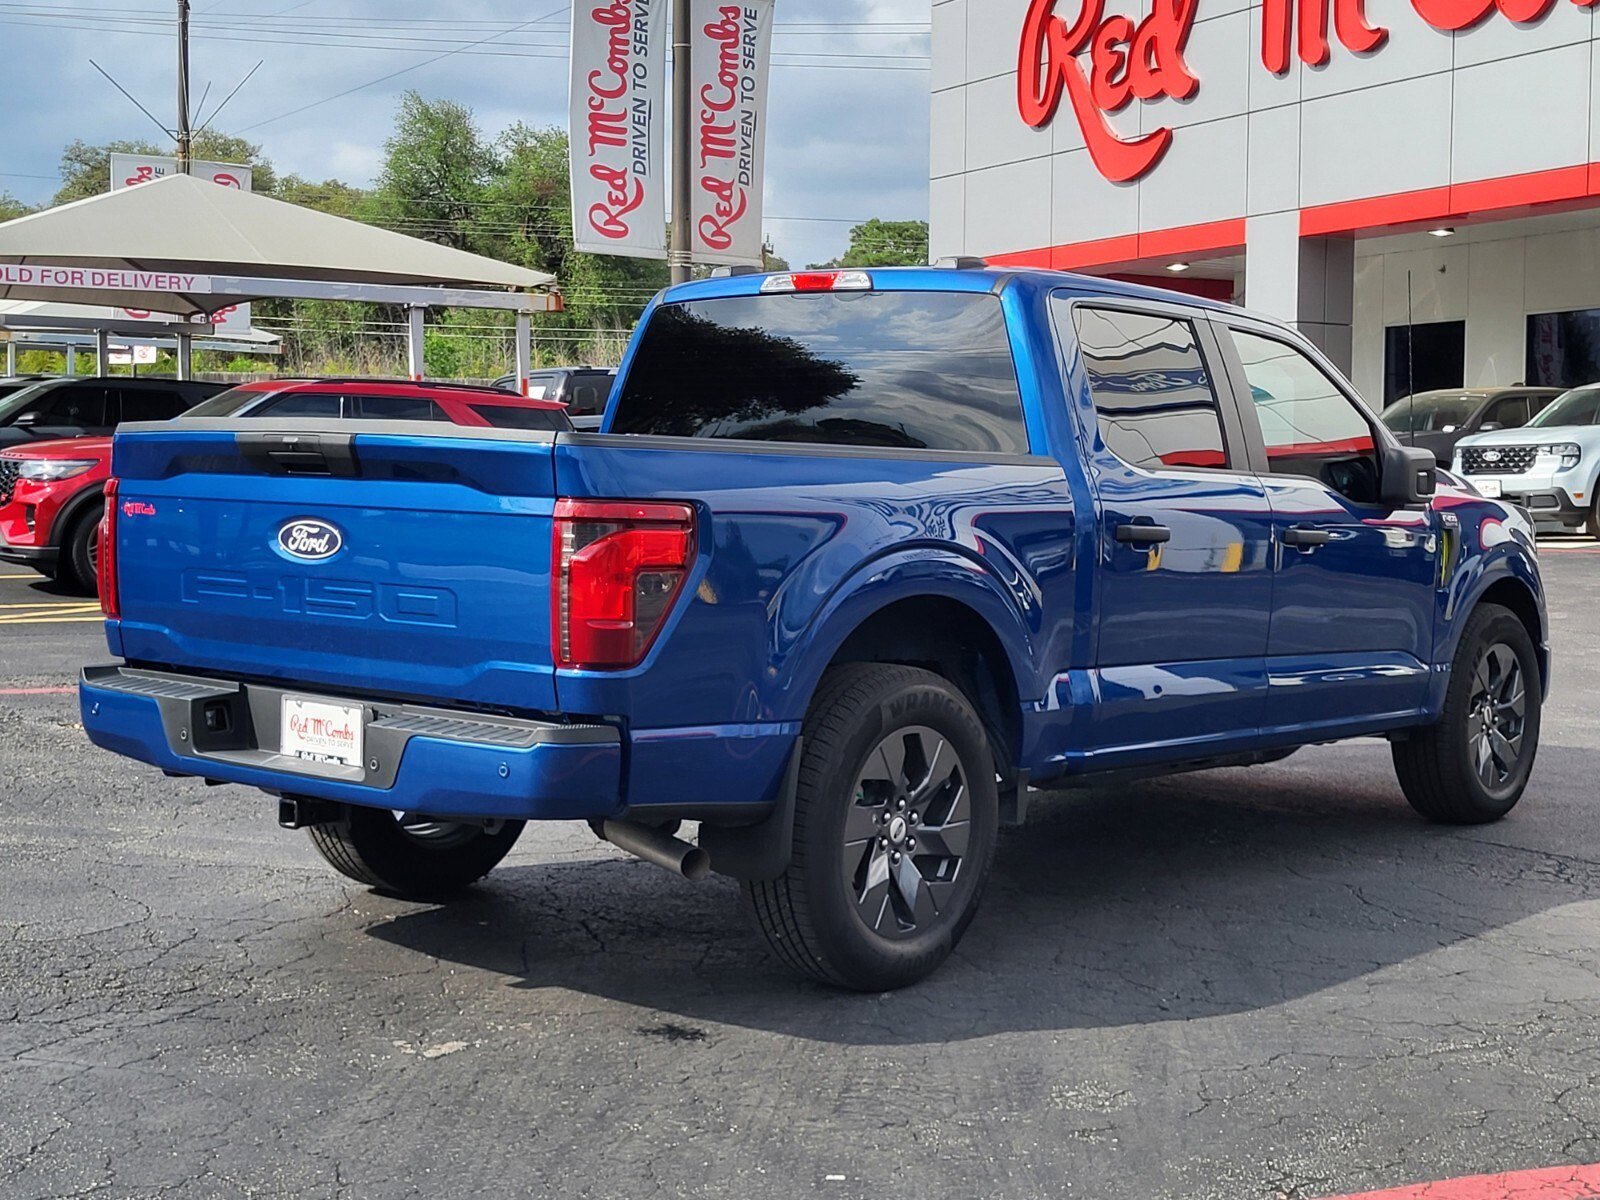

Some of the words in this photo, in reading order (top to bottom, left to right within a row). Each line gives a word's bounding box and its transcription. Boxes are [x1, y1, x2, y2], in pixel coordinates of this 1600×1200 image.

[742, 7, 758, 70] SERVE
[633, 62, 648, 91] TO
[700, 6, 741, 168] McCombs
[741, 76, 755, 103] TO
[1017, 0, 1200, 183] Red
[633, 98, 648, 176] DRIVEN
[738, 109, 754, 186] DRIVEN
[589, 164, 644, 239] Red
[698, 176, 747, 250] Red
[0, 267, 33, 283] LD
[40, 269, 84, 286] FOR
[92, 272, 195, 291] DELIVERY
[286, 525, 331, 553] Ford
[180, 566, 458, 628] F-150
[290, 714, 309, 740] Red
[311, 718, 354, 741] McCombs
